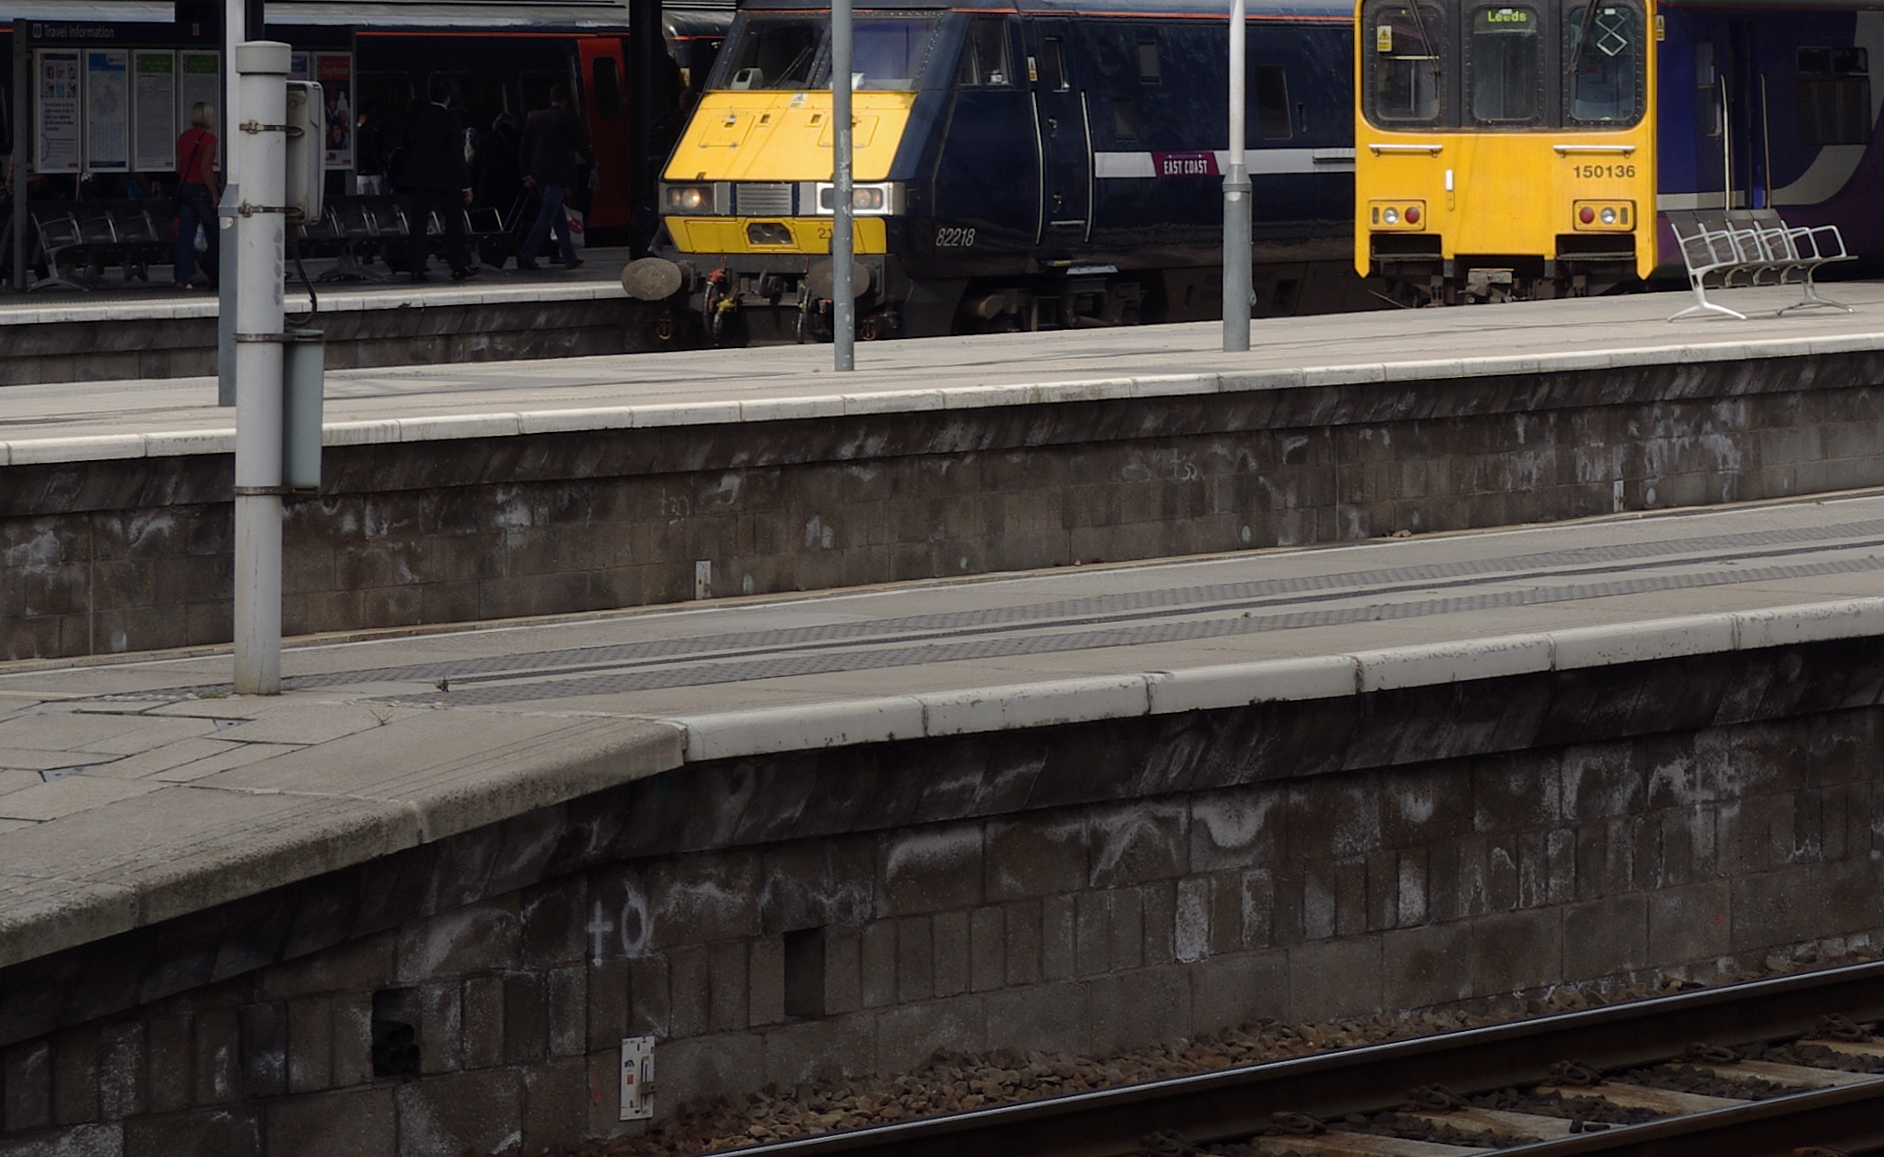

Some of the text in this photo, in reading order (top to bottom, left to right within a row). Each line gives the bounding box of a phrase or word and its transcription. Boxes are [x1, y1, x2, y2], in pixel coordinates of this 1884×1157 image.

[1487, 9, 1528, 23] Leeds
[44, 24, 115, 39] Travel information
[1163, 159, 1208, 175] EAST COAST
[1573, 164, 1636, 179] 150136
[935, 226, 977, 247] 82218
